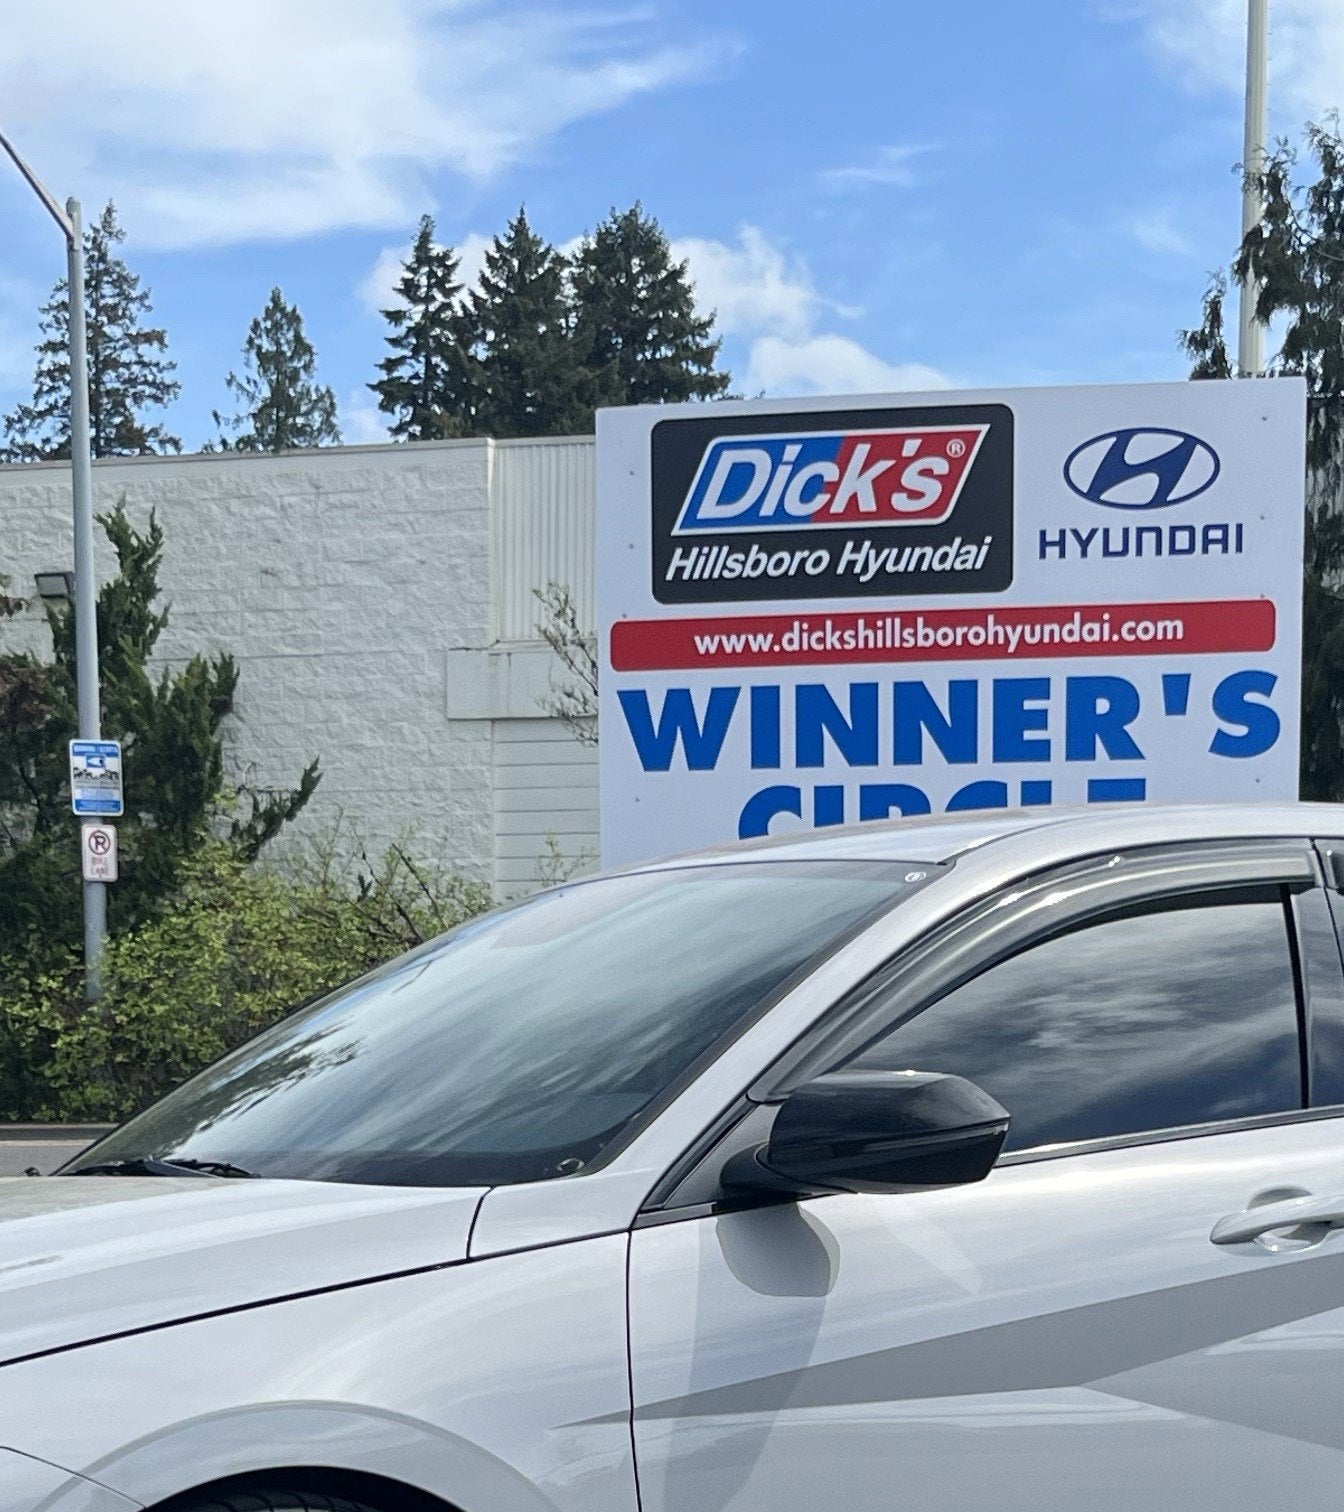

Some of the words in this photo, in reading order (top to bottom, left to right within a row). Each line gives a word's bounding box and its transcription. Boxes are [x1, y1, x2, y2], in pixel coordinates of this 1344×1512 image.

[665, 542, 831, 583] Hillsboro
[837, 536, 992, 584] Hyundai
[1038, 523, 1244, 560] HYUNDAI
[694, 613, 1185, 656] www.dickshillsborohyundai.com
[617, 669, 1282, 773] WINNER'S
